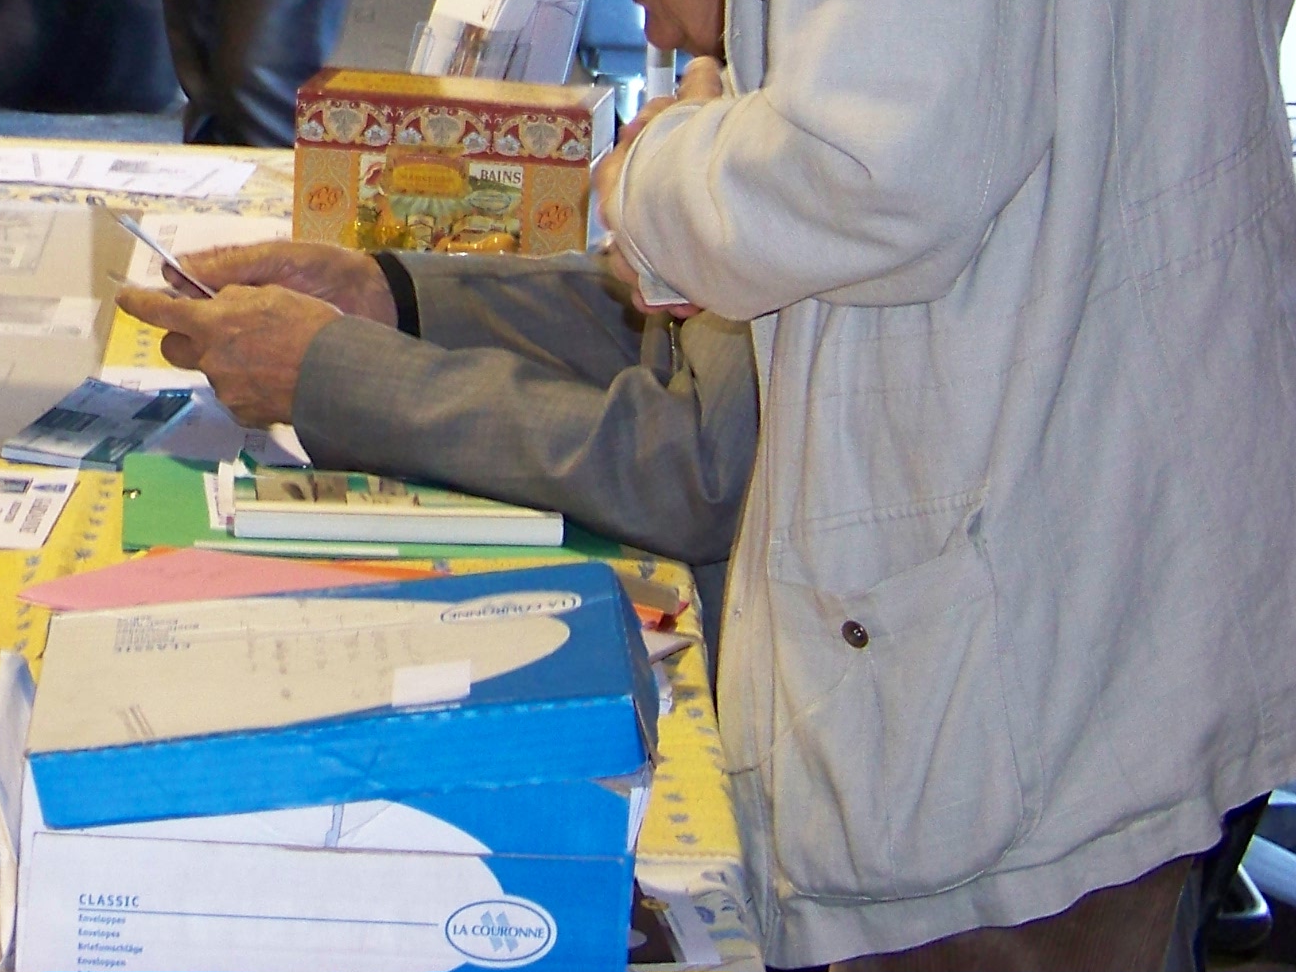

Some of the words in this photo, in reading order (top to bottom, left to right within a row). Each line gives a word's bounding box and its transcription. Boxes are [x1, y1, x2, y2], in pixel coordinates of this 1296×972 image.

[480, 169, 522, 184] BAINS
[79, 893, 140, 908] CLASSIC
[78, 928, 121, 939] Envelopes
[453, 924, 468, 936] LA
[471, 924, 544, 939] COURONNE
